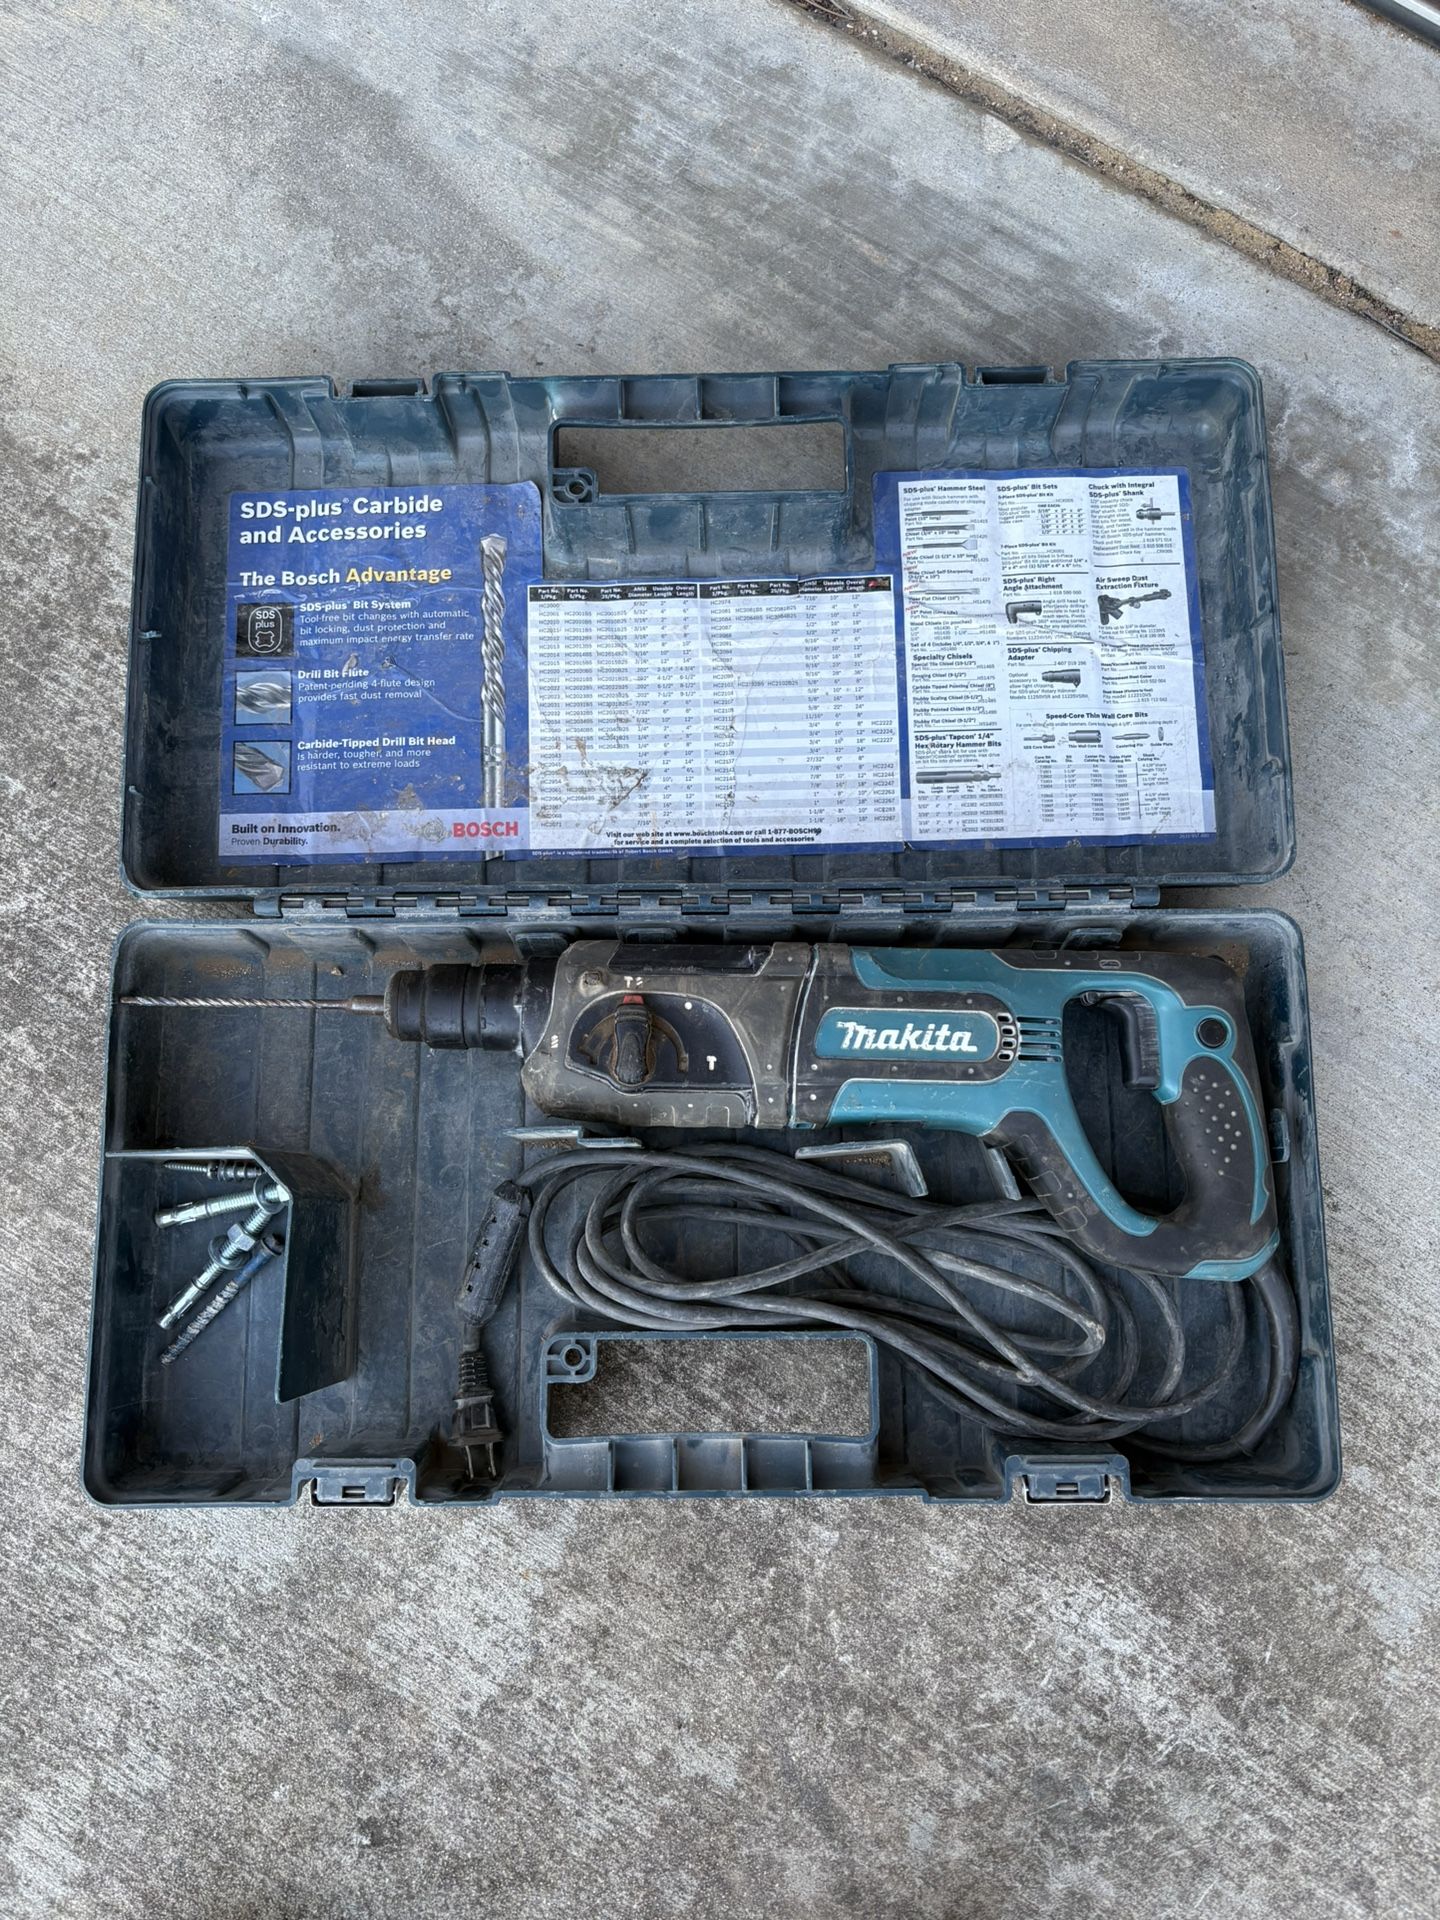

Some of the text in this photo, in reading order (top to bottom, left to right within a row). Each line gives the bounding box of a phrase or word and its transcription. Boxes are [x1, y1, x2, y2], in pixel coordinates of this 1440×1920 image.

[938, 484, 966, 492] Hammer
[353, 495, 443, 514] Carbide
[240, 522, 427, 544] and Accessories
[240, 567, 451, 586] The Bosch Advantage
[1037, 576, 1056, 584] Right
[1107, 576, 1131, 584] Sweep
[1003, 583, 1063, 592] Angle Attachment
[1096, 582, 1132, 590] Extraction
[353, 601, 369, 610] Bit
[371, 600, 411, 611] System
[255, 610, 275, 619] SDS
[300, 609, 470, 623] Tool-free bit changes with automatic
[255, 620, 275, 630] plus
[300, 620, 446, 635] bit locking, dust protection and
[300, 631, 474, 646] maximum impact energy transfer rate
[1042, 646, 1072, 654] Chipping
[913, 652, 973, 662] Specialty Chisels
[1008, 654, 1035, 662] Adapter
[298, 669, 321, 679] Drill
[323, 669, 339, 678] Bit
[298, 677, 435, 692] Patent-pending 4-flute design
[298, 690, 422, 702] provides fast dust removal
[978, 732, 994, 740] 1/4"
[297, 735, 456, 750] Carbide-Tipped Drill Bit Head
[930, 741, 954, 749] Rotary
[297, 748, 432, 760] Is harder, tougher, and more
[297, 759, 420, 771] resistant to extreme loads
[231, 823, 341, 834] Built on Innovation.
[452, 821, 519, 838] BOSCH
[231, 836, 309, 847] Proven Durability.
[671, 838, 702, 846] complete
[775, 835, 814, 843] accessories
